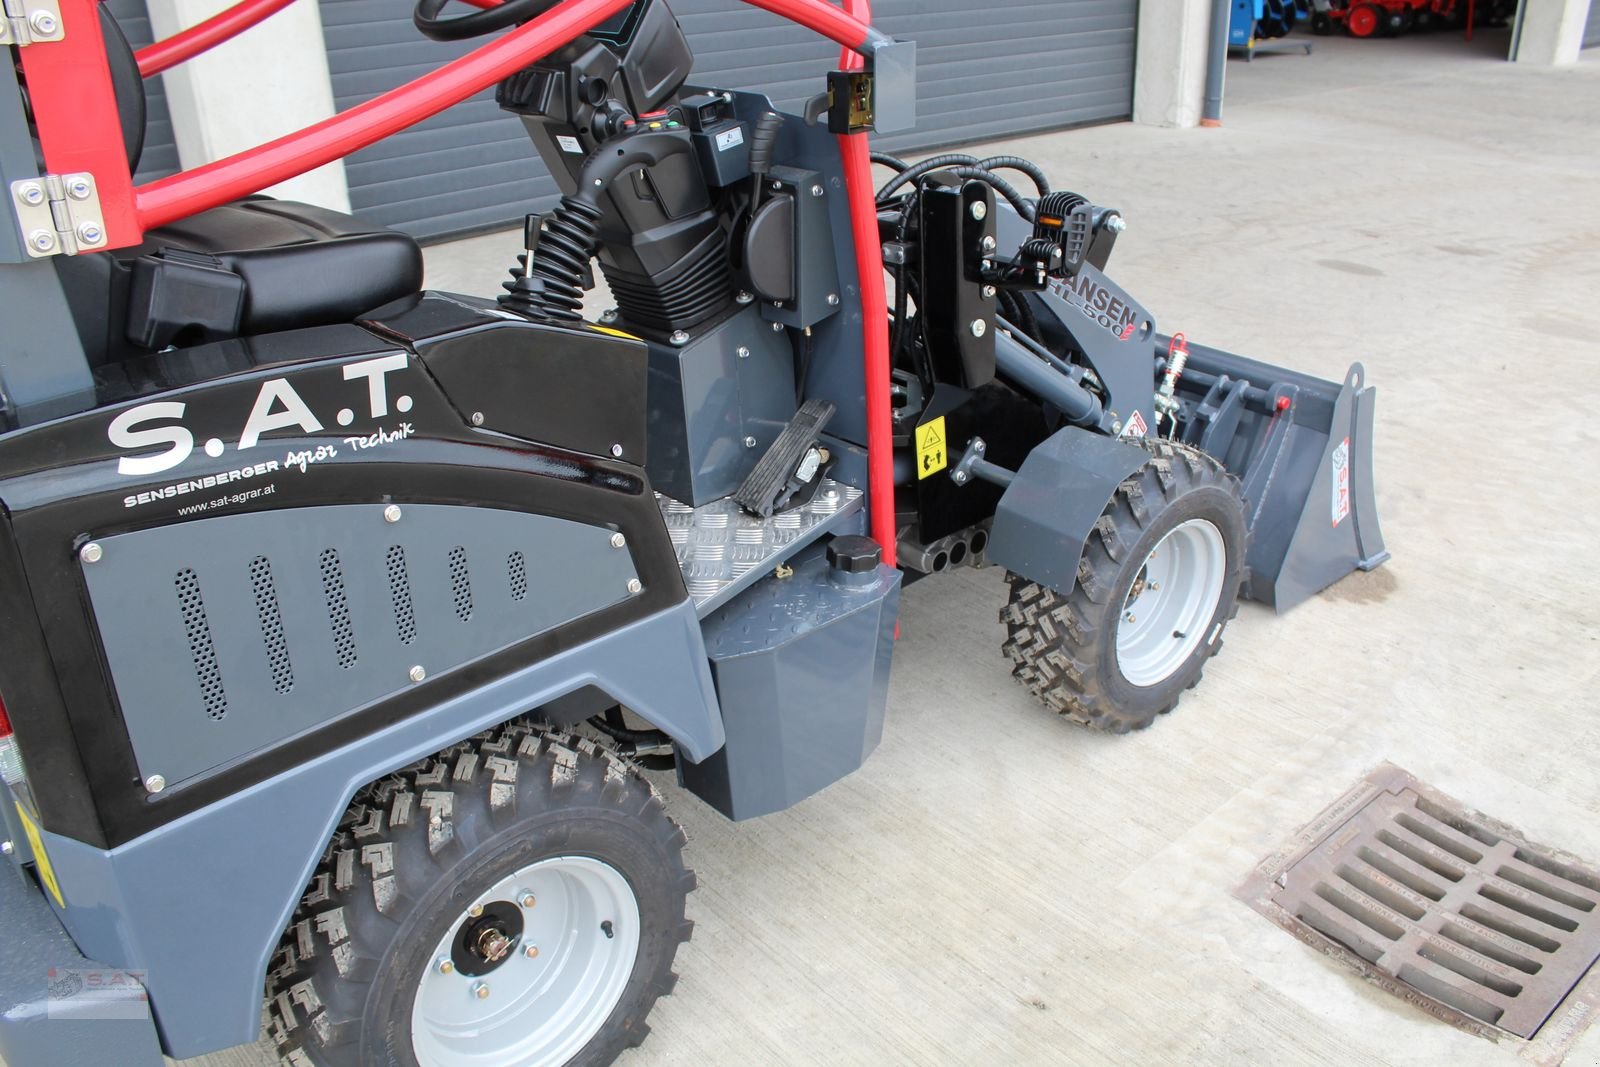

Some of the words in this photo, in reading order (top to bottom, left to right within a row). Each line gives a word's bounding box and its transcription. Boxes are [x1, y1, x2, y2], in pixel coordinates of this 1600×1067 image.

[1053, 274, 1136, 326] ANSEN
[108, 354, 413, 475] S.A.T.
[123, 460, 279, 508] SENSENBERGER
[284, 444, 338, 474] Agrar
[343, 422, 416, 452] Technik
[178, 483, 276, 517] www.sat-agrar.at
